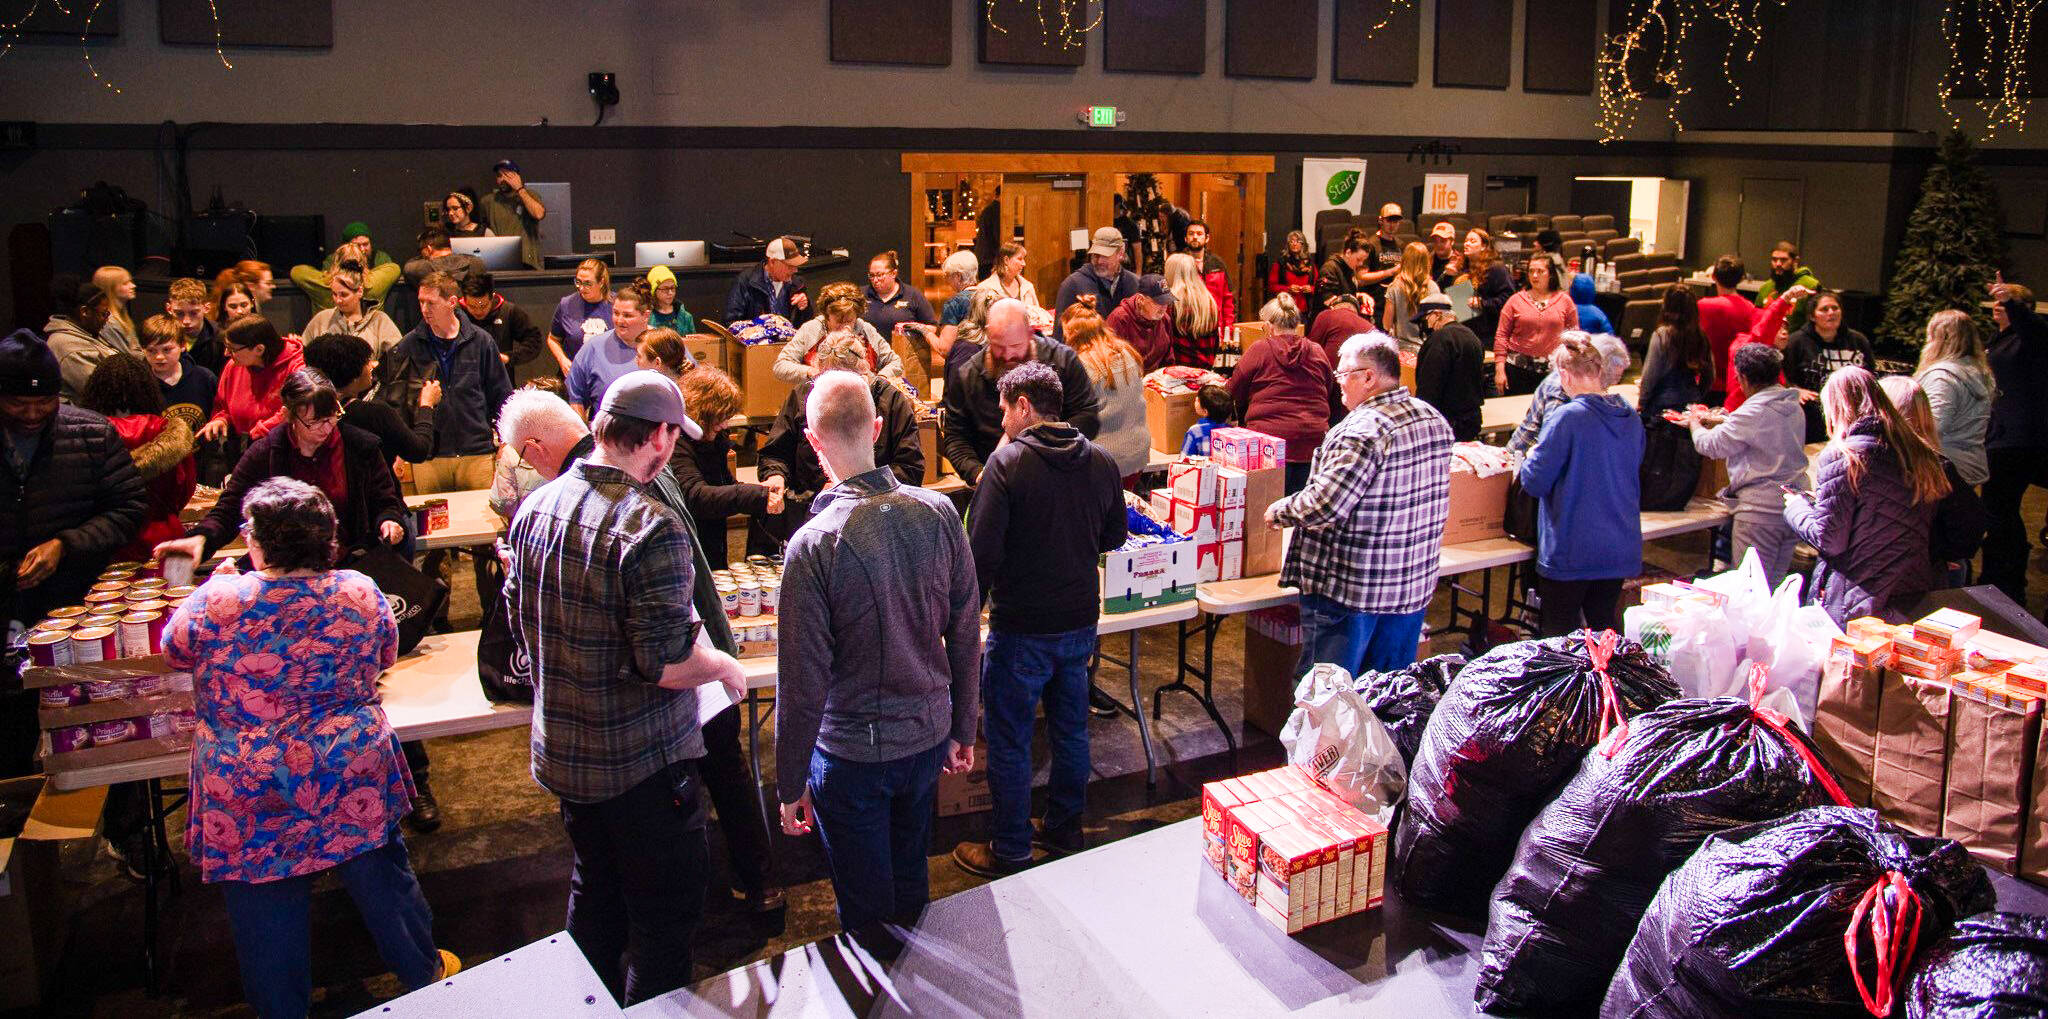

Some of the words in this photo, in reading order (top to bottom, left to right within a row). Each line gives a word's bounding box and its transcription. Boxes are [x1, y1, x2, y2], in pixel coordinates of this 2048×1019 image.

[1094, 108, 1114, 124] EXIT
[1328, 173, 1357, 200] Start
[1431, 183, 1458, 209] life
[1203, 798, 1222, 822] Stove
[1209, 817, 1220, 833] Top
[1229, 823, 1252, 848] Stove
[1236, 842, 1249, 860] Top
